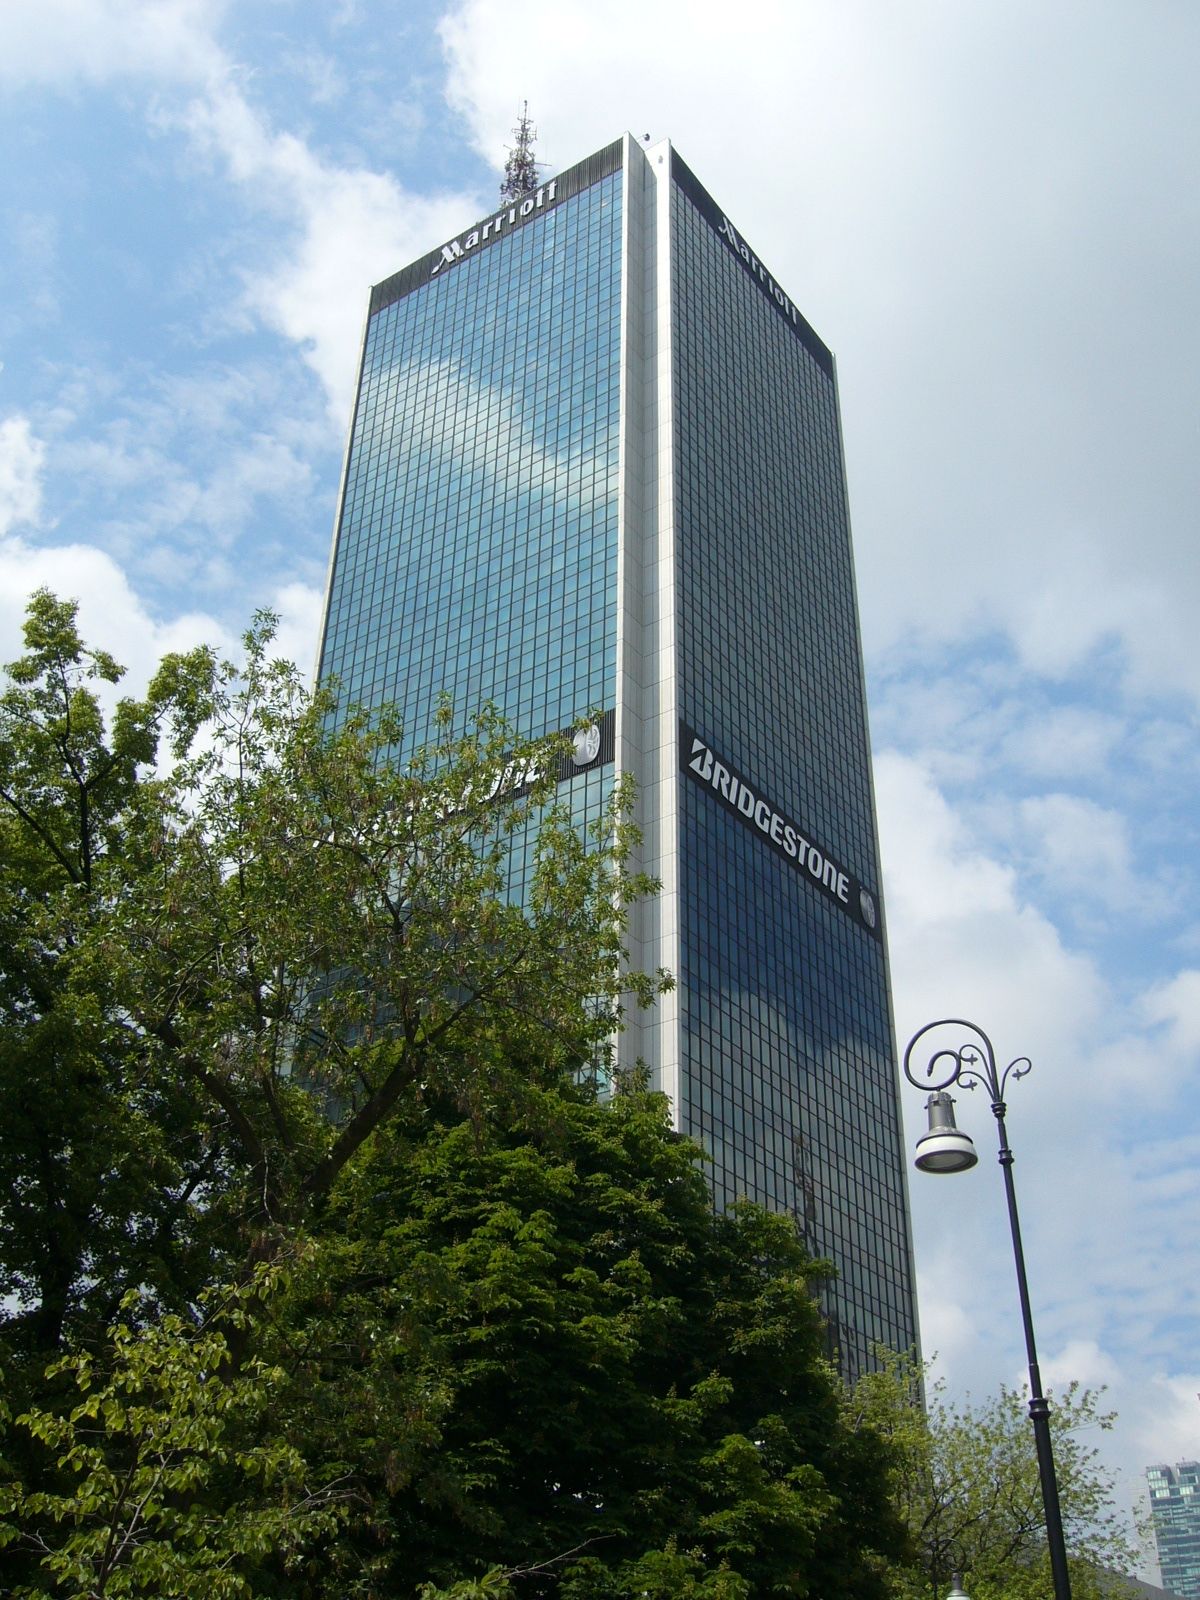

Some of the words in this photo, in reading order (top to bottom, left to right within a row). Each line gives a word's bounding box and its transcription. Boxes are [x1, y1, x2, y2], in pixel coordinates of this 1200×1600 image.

[432, 180, 557, 275] Marriott
[718, 216, 797, 325] Marriott
[688, 738, 849, 904] BRIDGESTONE
